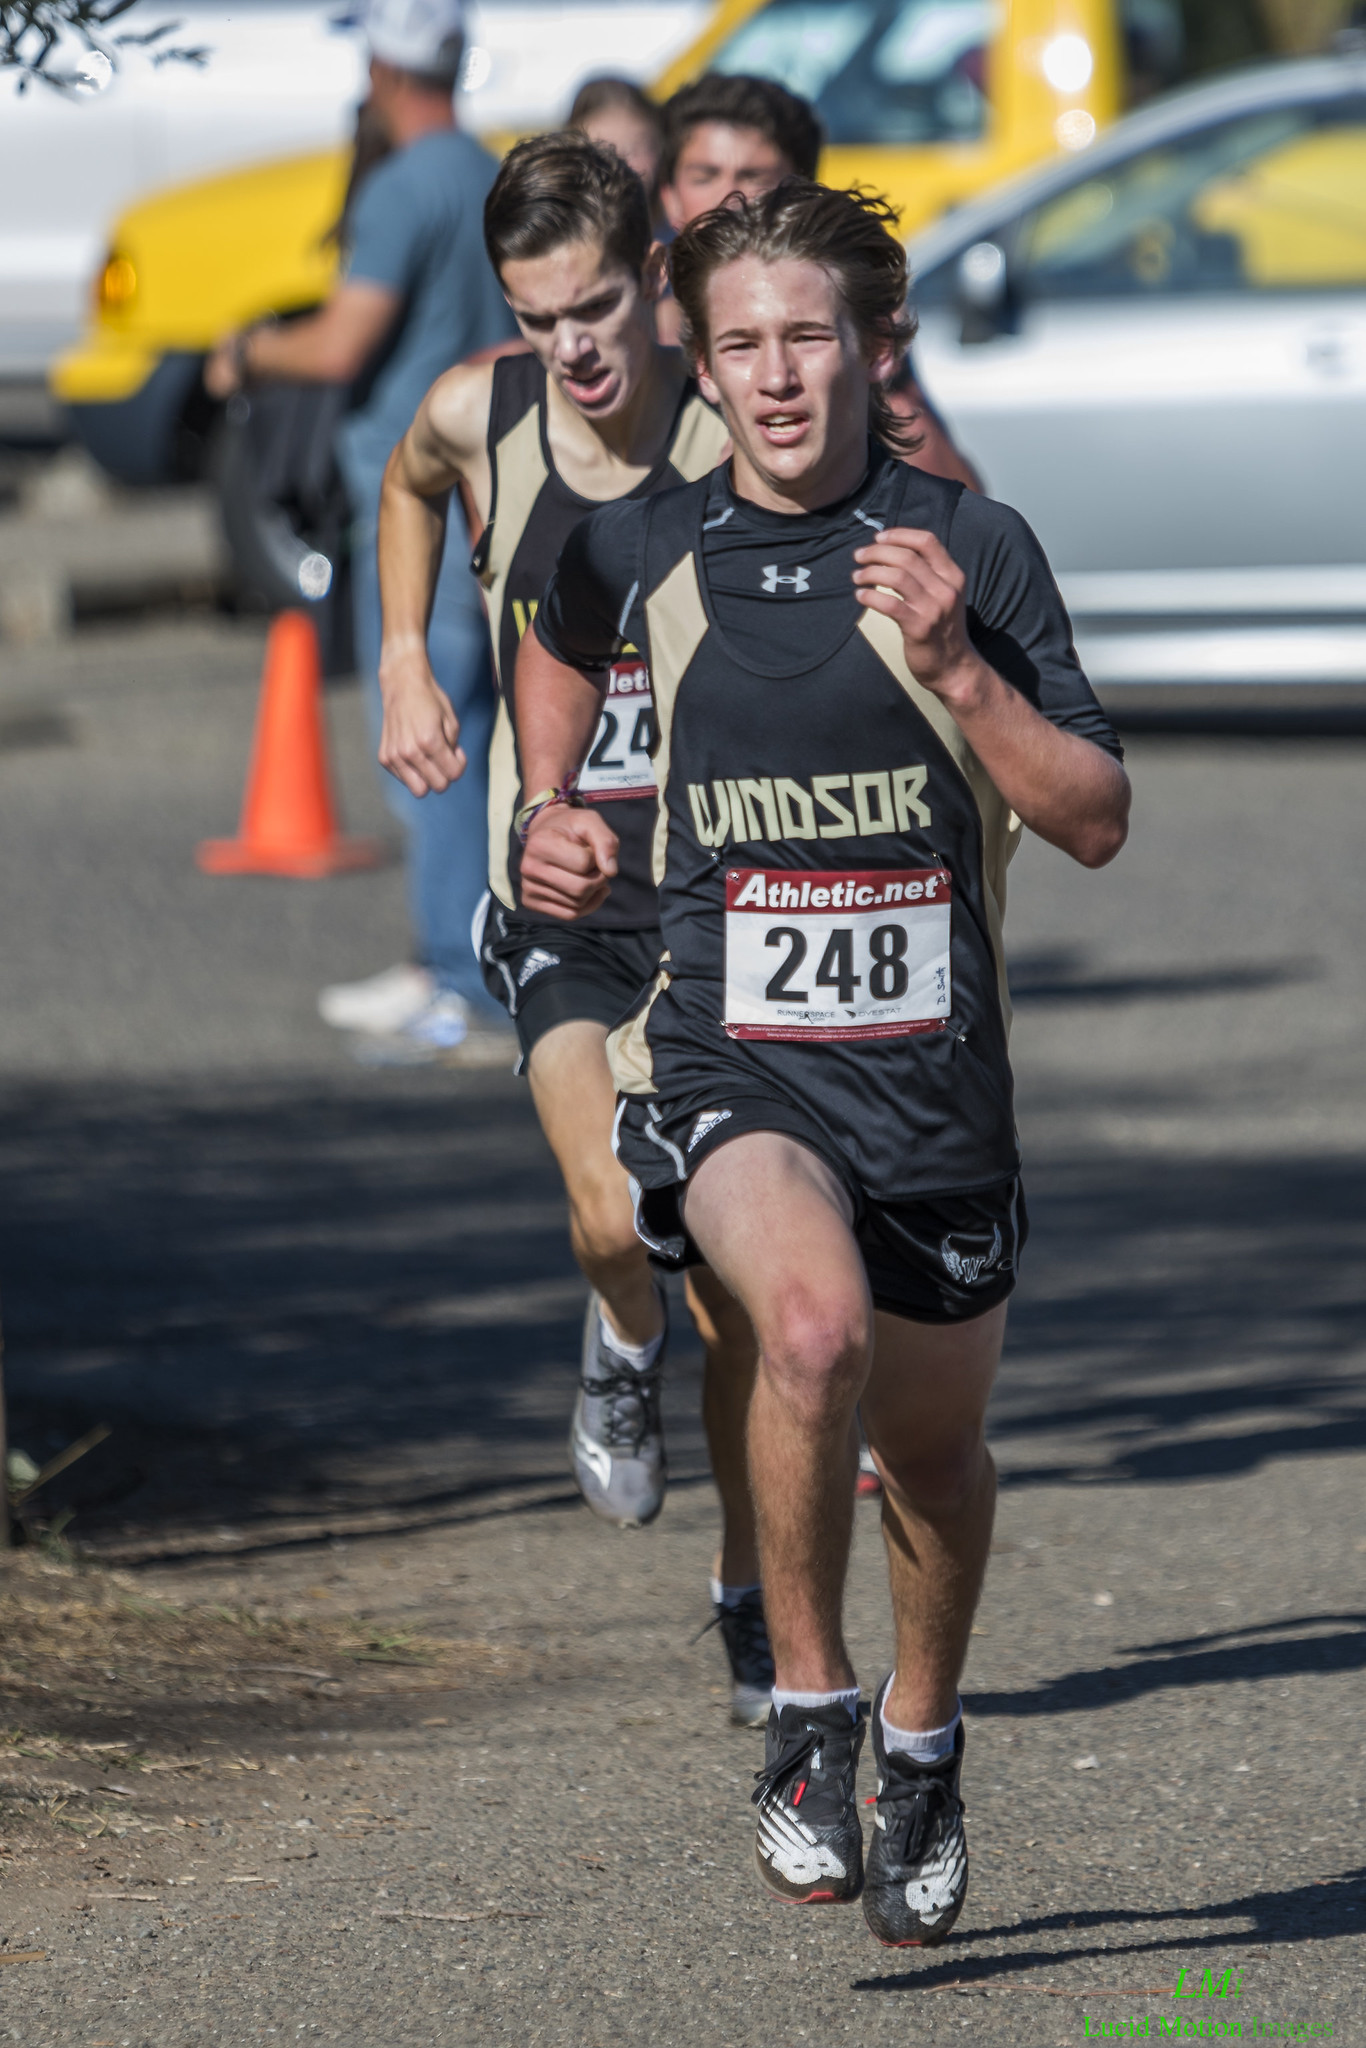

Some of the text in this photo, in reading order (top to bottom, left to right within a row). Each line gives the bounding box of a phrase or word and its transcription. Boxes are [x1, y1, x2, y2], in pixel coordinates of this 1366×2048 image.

[687, 764, 932, 848] WINDSOR
[733, 872, 939, 909] Athletic.net
[764, 923, 909, 1004] 248
[687, 1108, 733, 1153] adidas
[961, 1256, 986, 1284] W
